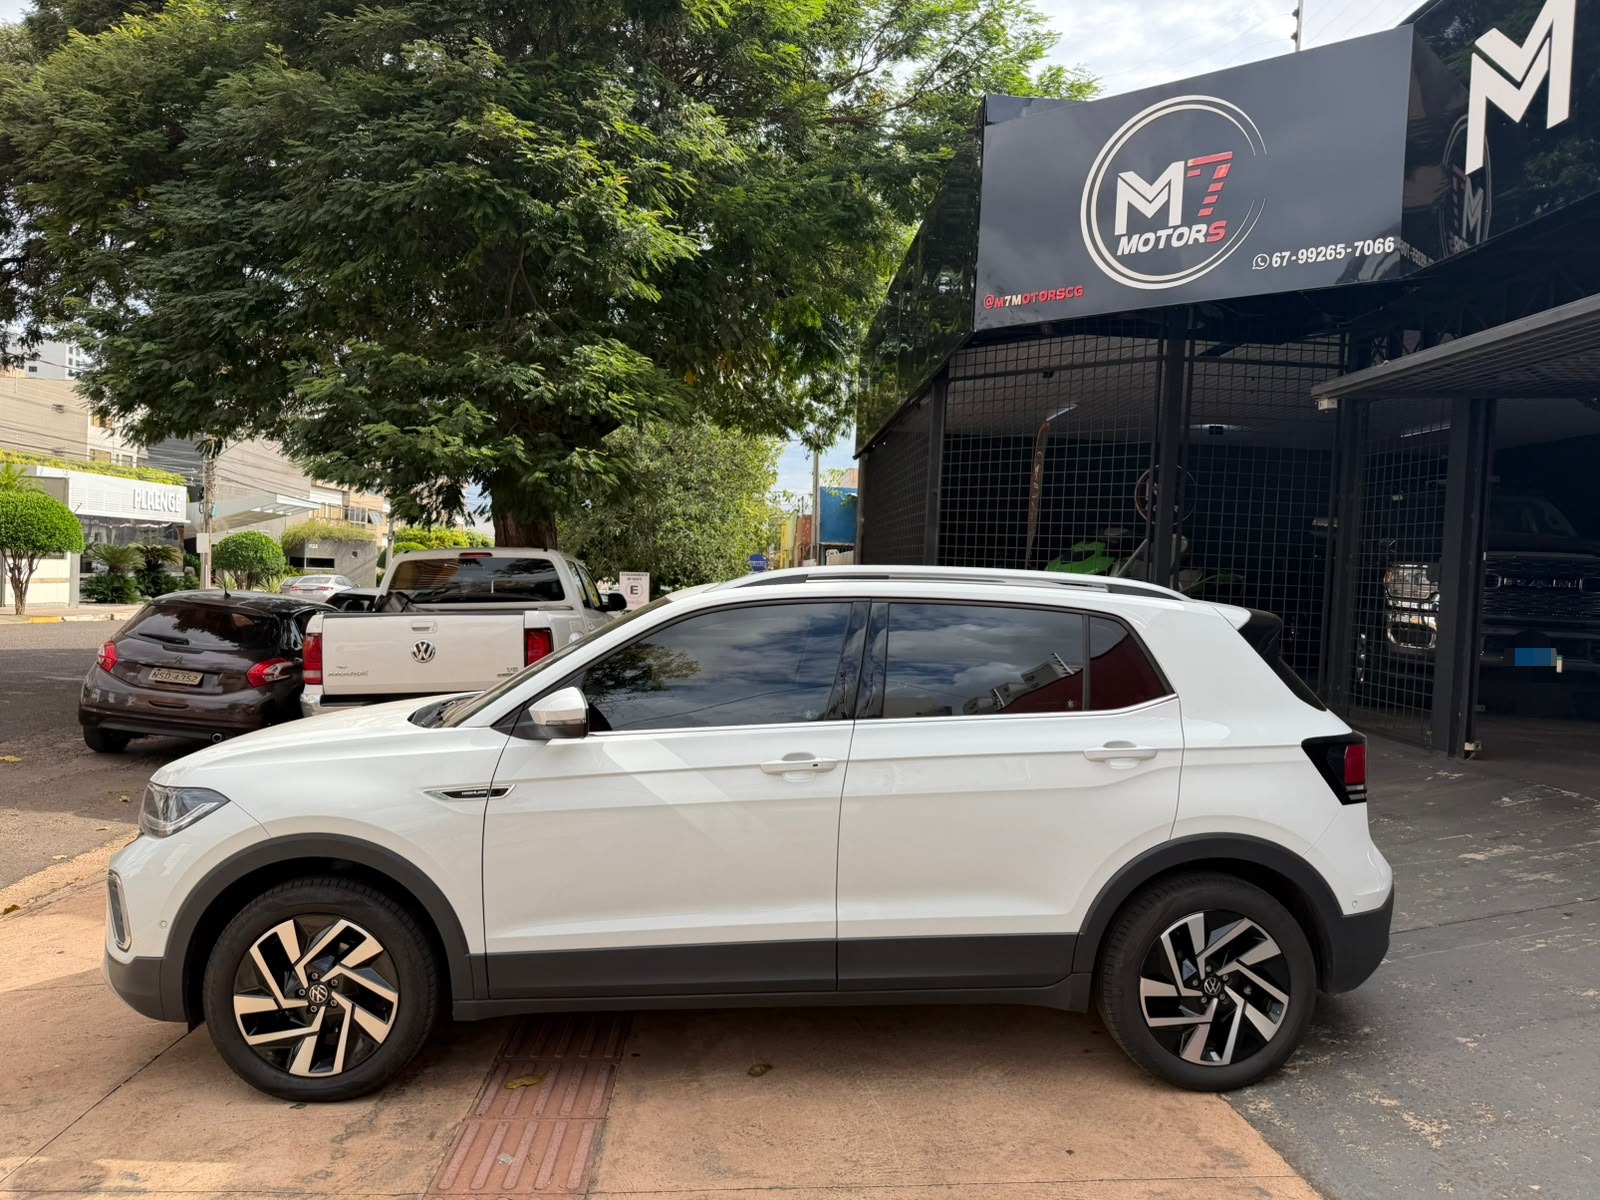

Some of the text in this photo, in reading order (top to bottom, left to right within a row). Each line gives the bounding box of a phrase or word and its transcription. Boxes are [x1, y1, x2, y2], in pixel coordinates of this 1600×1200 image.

[1114, 151, 1233, 236] M7
[1116, 220, 1228, 256] MOTORS
[1271, 236, 1396, 268] 67-99265-7066
[983, 285, 1085, 309] @M7MOTORSCG
[132, 488, 181, 512] PLAENGE
[630, 585, 639, 595] E
